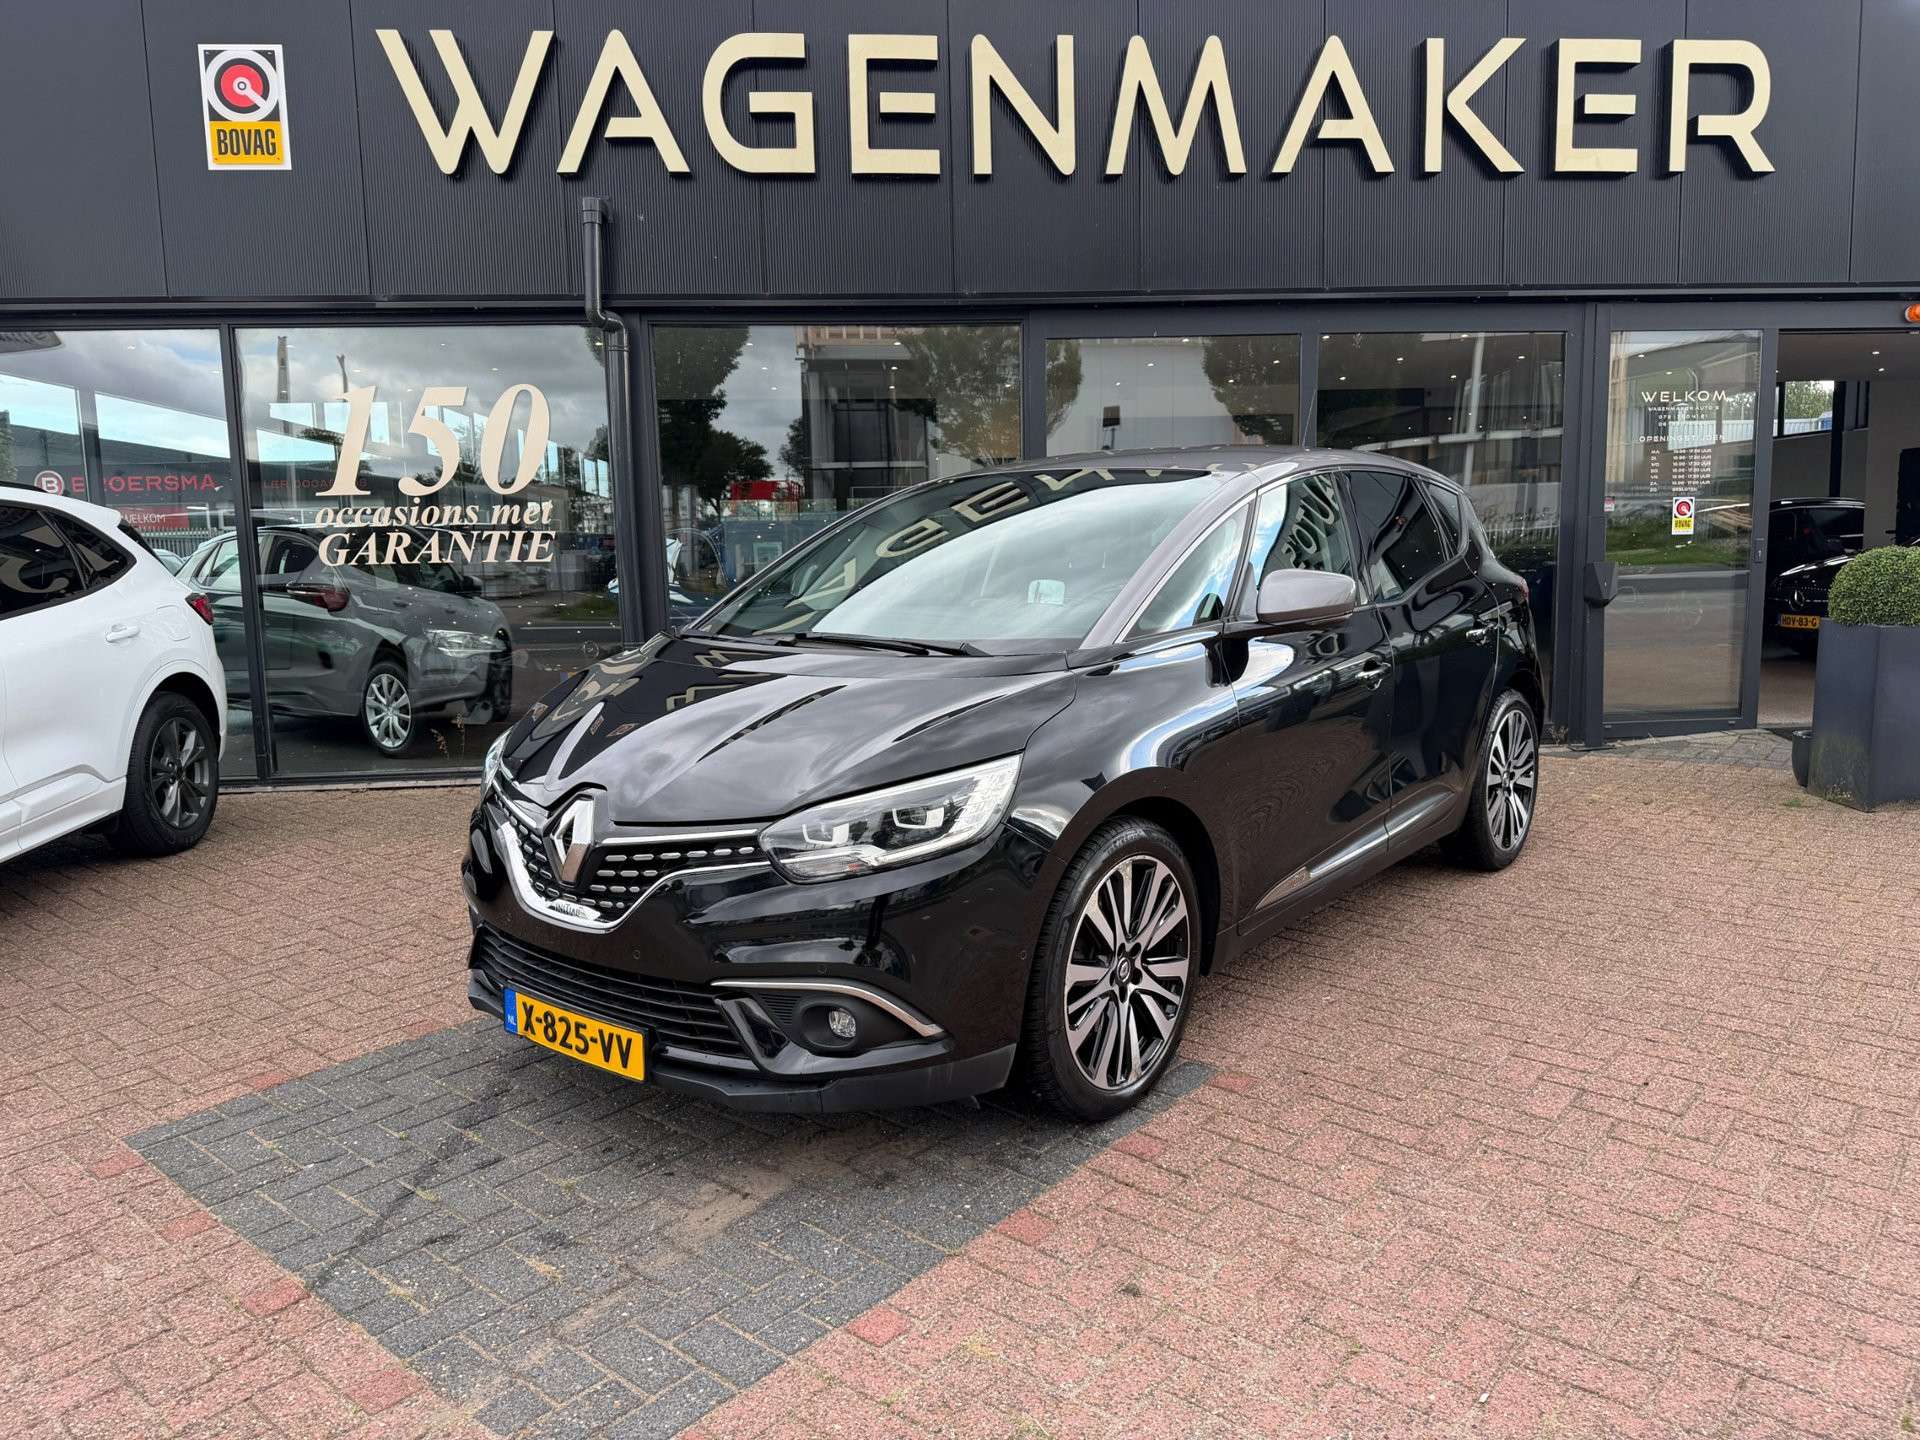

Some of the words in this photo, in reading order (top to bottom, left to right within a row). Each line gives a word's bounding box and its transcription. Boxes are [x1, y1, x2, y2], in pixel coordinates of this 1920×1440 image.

[375, 29, 1775, 176] WAGENMAKER
[216, 128, 277, 157] BOVAG
[1641, 390, 1727, 403] WELKOM
[316, 384, 550, 496] 150
[315, 497, 480, 527] occasions
[492, 499, 553, 526] met
[318, 530, 556, 567] GARANTIE
[507, 1014, 517, 1026] NL
[522, 1001, 632, 1069] X-825-VV
